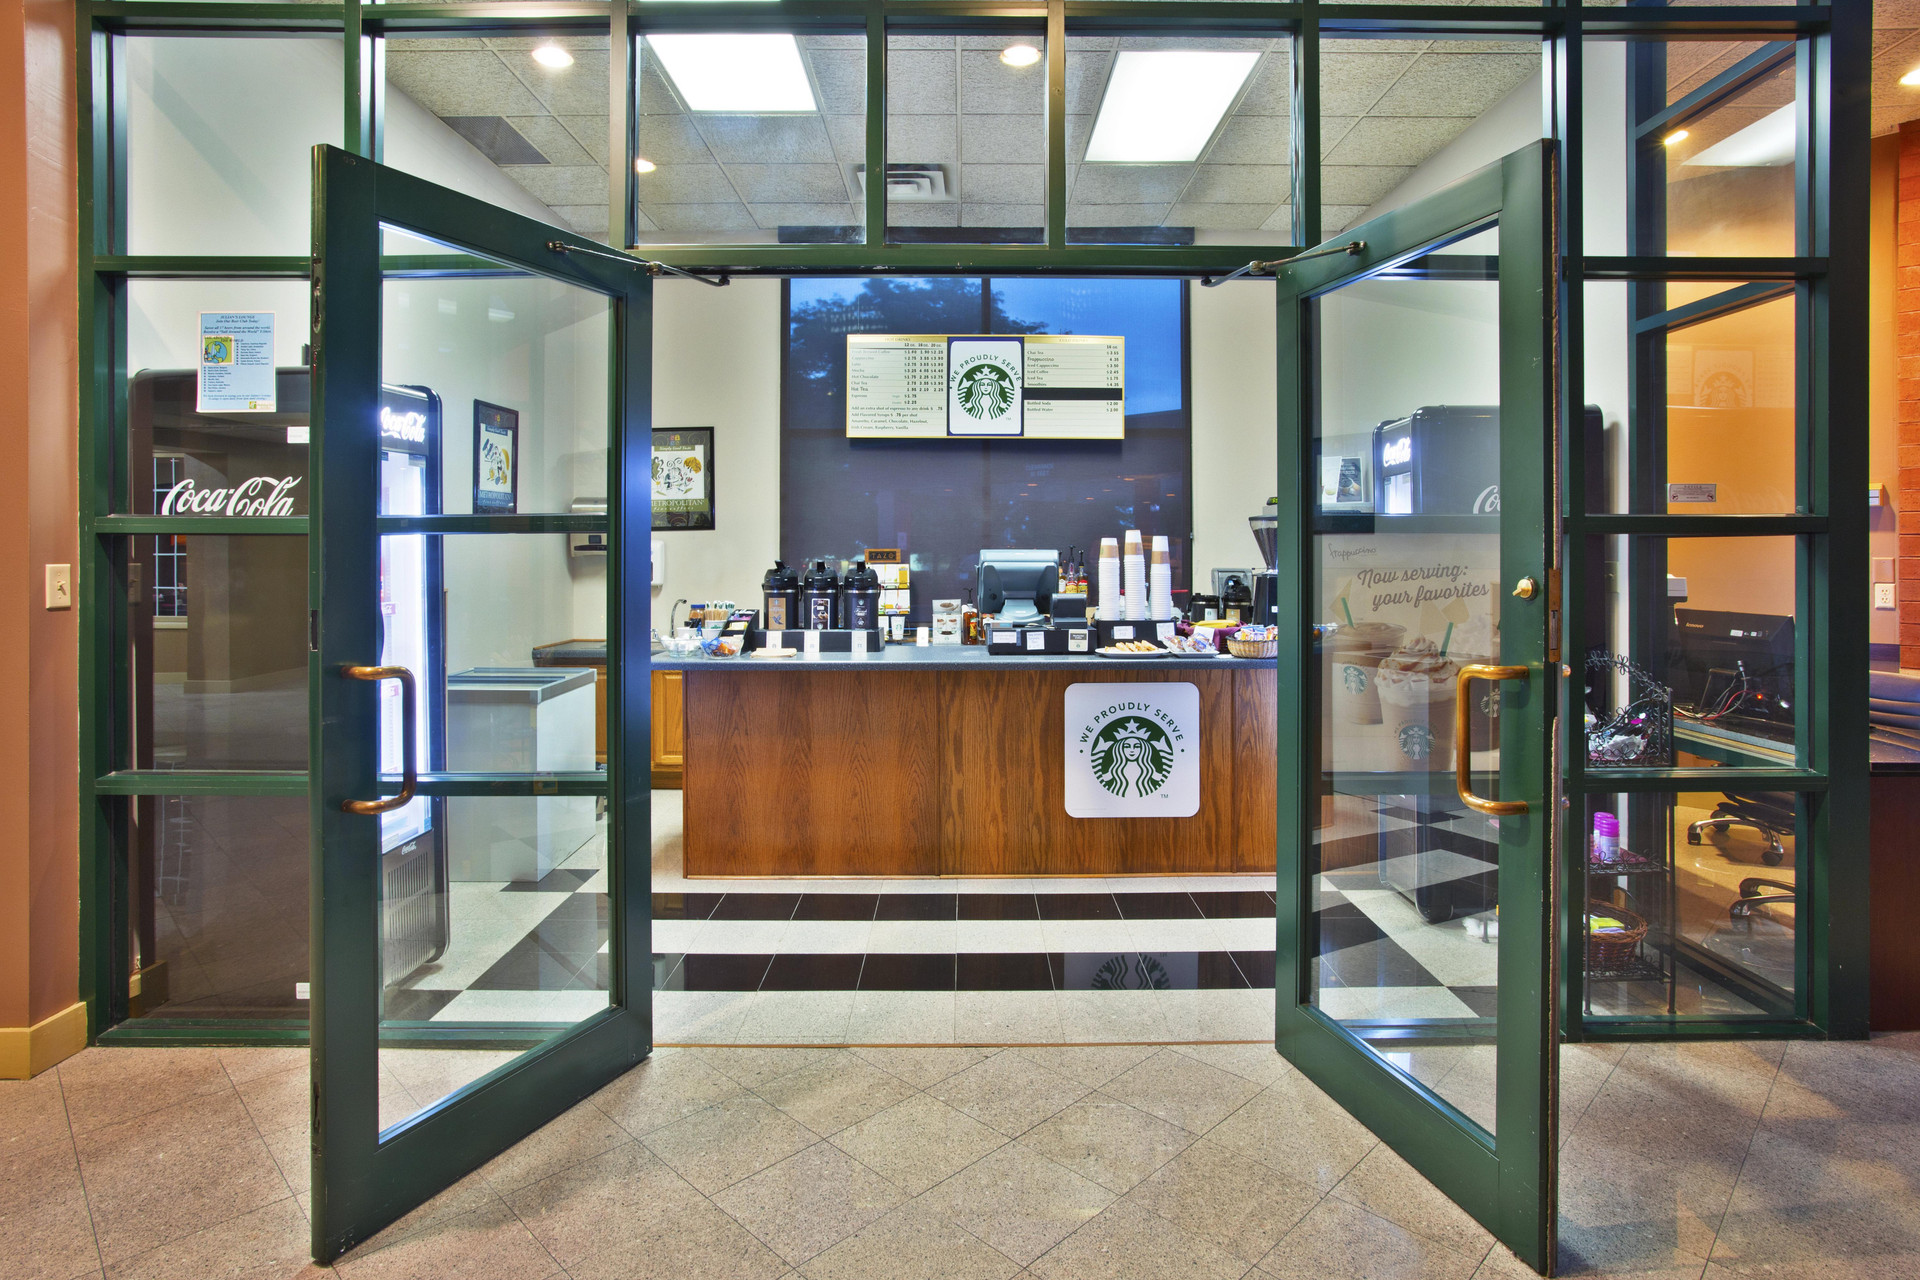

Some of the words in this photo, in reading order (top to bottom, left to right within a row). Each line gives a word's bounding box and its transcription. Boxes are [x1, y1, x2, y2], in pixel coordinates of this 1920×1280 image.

[950, 370, 960, 382] WE
[960, 354, 999, 369] PROUDLY
[1001, 359, 1022, 382] SERVE
[162, 476, 302, 515] Coca-Cola
[1357, 568, 1398, 588] Now
[1401, 563, 1469, 582] serving:
[1372, 592, 1413, 612] your
[1414, 582, 1489, 608] favorites
[1080, 725, 1094, 744] WE
[1093, 702, 1150, 724] PROUDLY
[1154, 709, 1184, 742] SERVE
